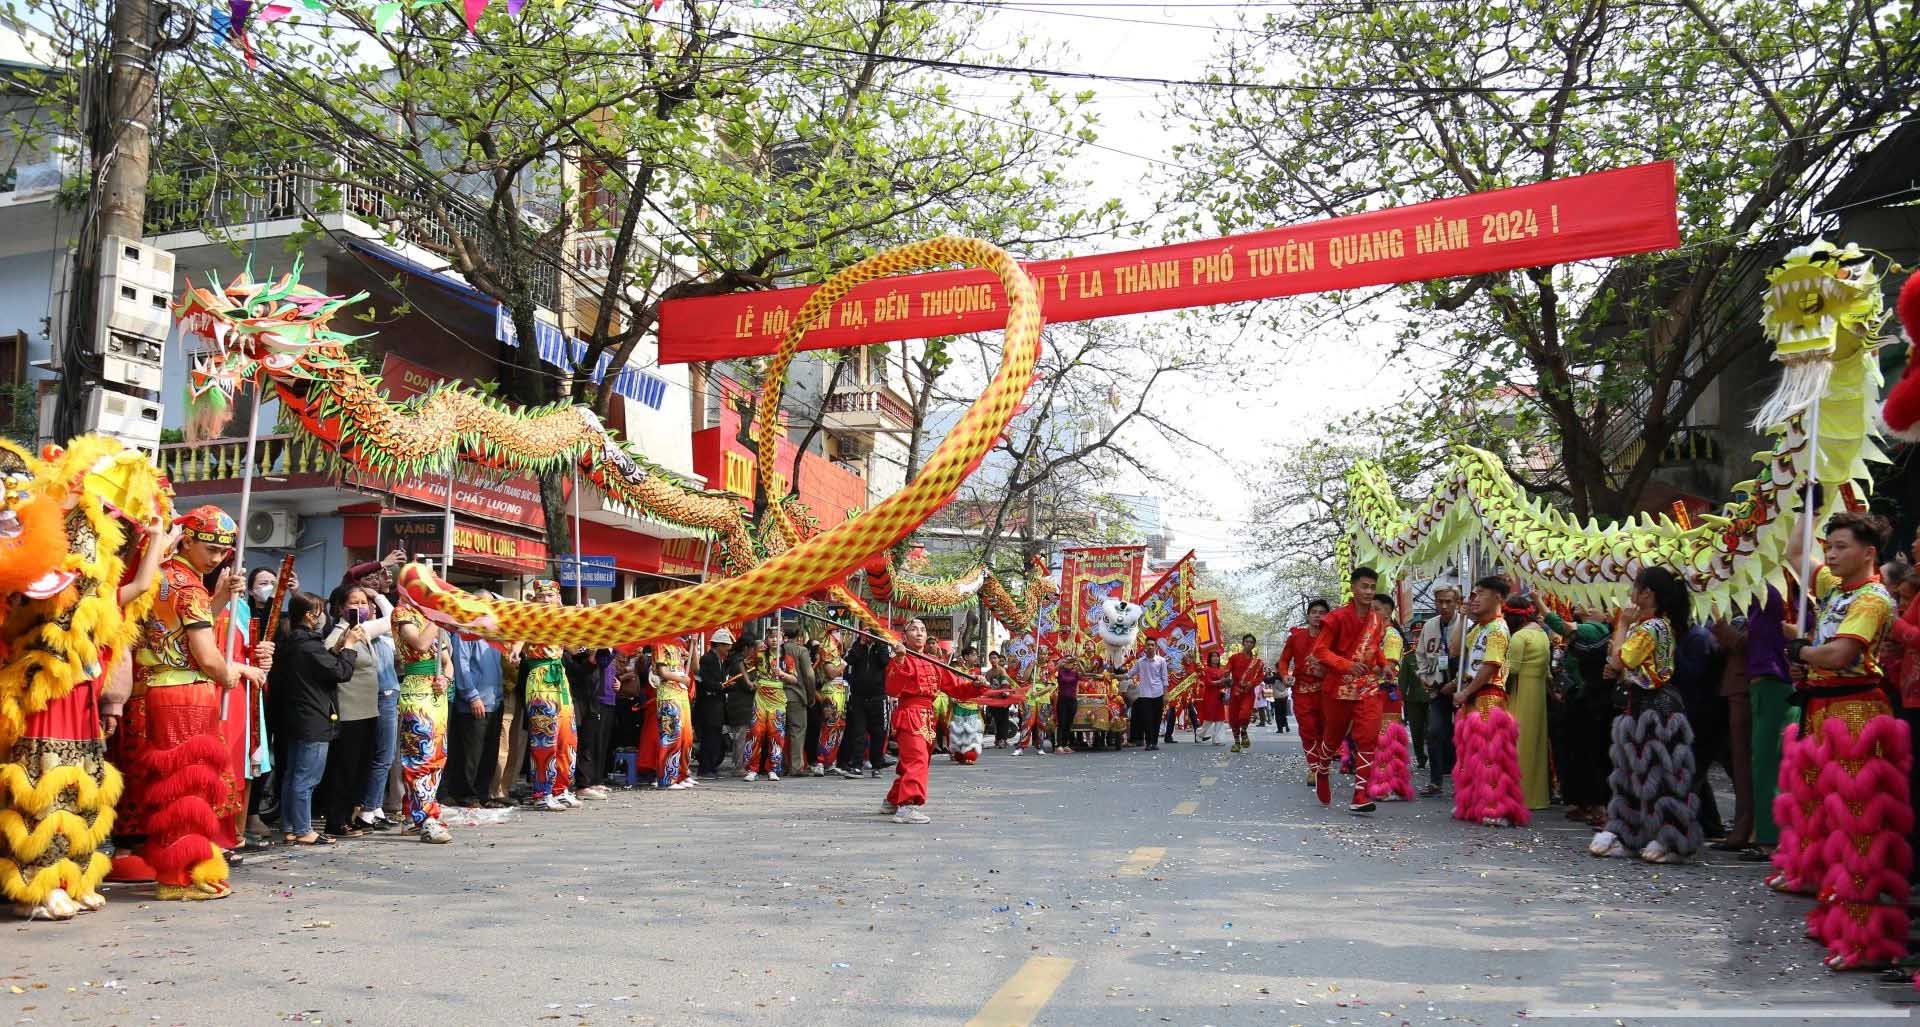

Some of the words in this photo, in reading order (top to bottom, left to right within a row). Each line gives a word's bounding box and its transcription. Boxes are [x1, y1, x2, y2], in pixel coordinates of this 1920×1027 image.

[921, 284, 996, 320] THƯỢNG,
[1080, 270, 1103, 298] LA
[1114, 260, 1180, 295] THÀNH
[1192, 244, 1235, 285] PHỐ
[1248, 239, 1314, 278] TUYÊN
[1329, 229, 1404, 270] QUANG
[1415, 215, 1469, 254] NĂM
[1482, 208, 1539, 244] 2024
[1551, 204, 1560, 234] !
[727, 450, 753, 499] KIM
[494, 537, 517, 557] LONG
